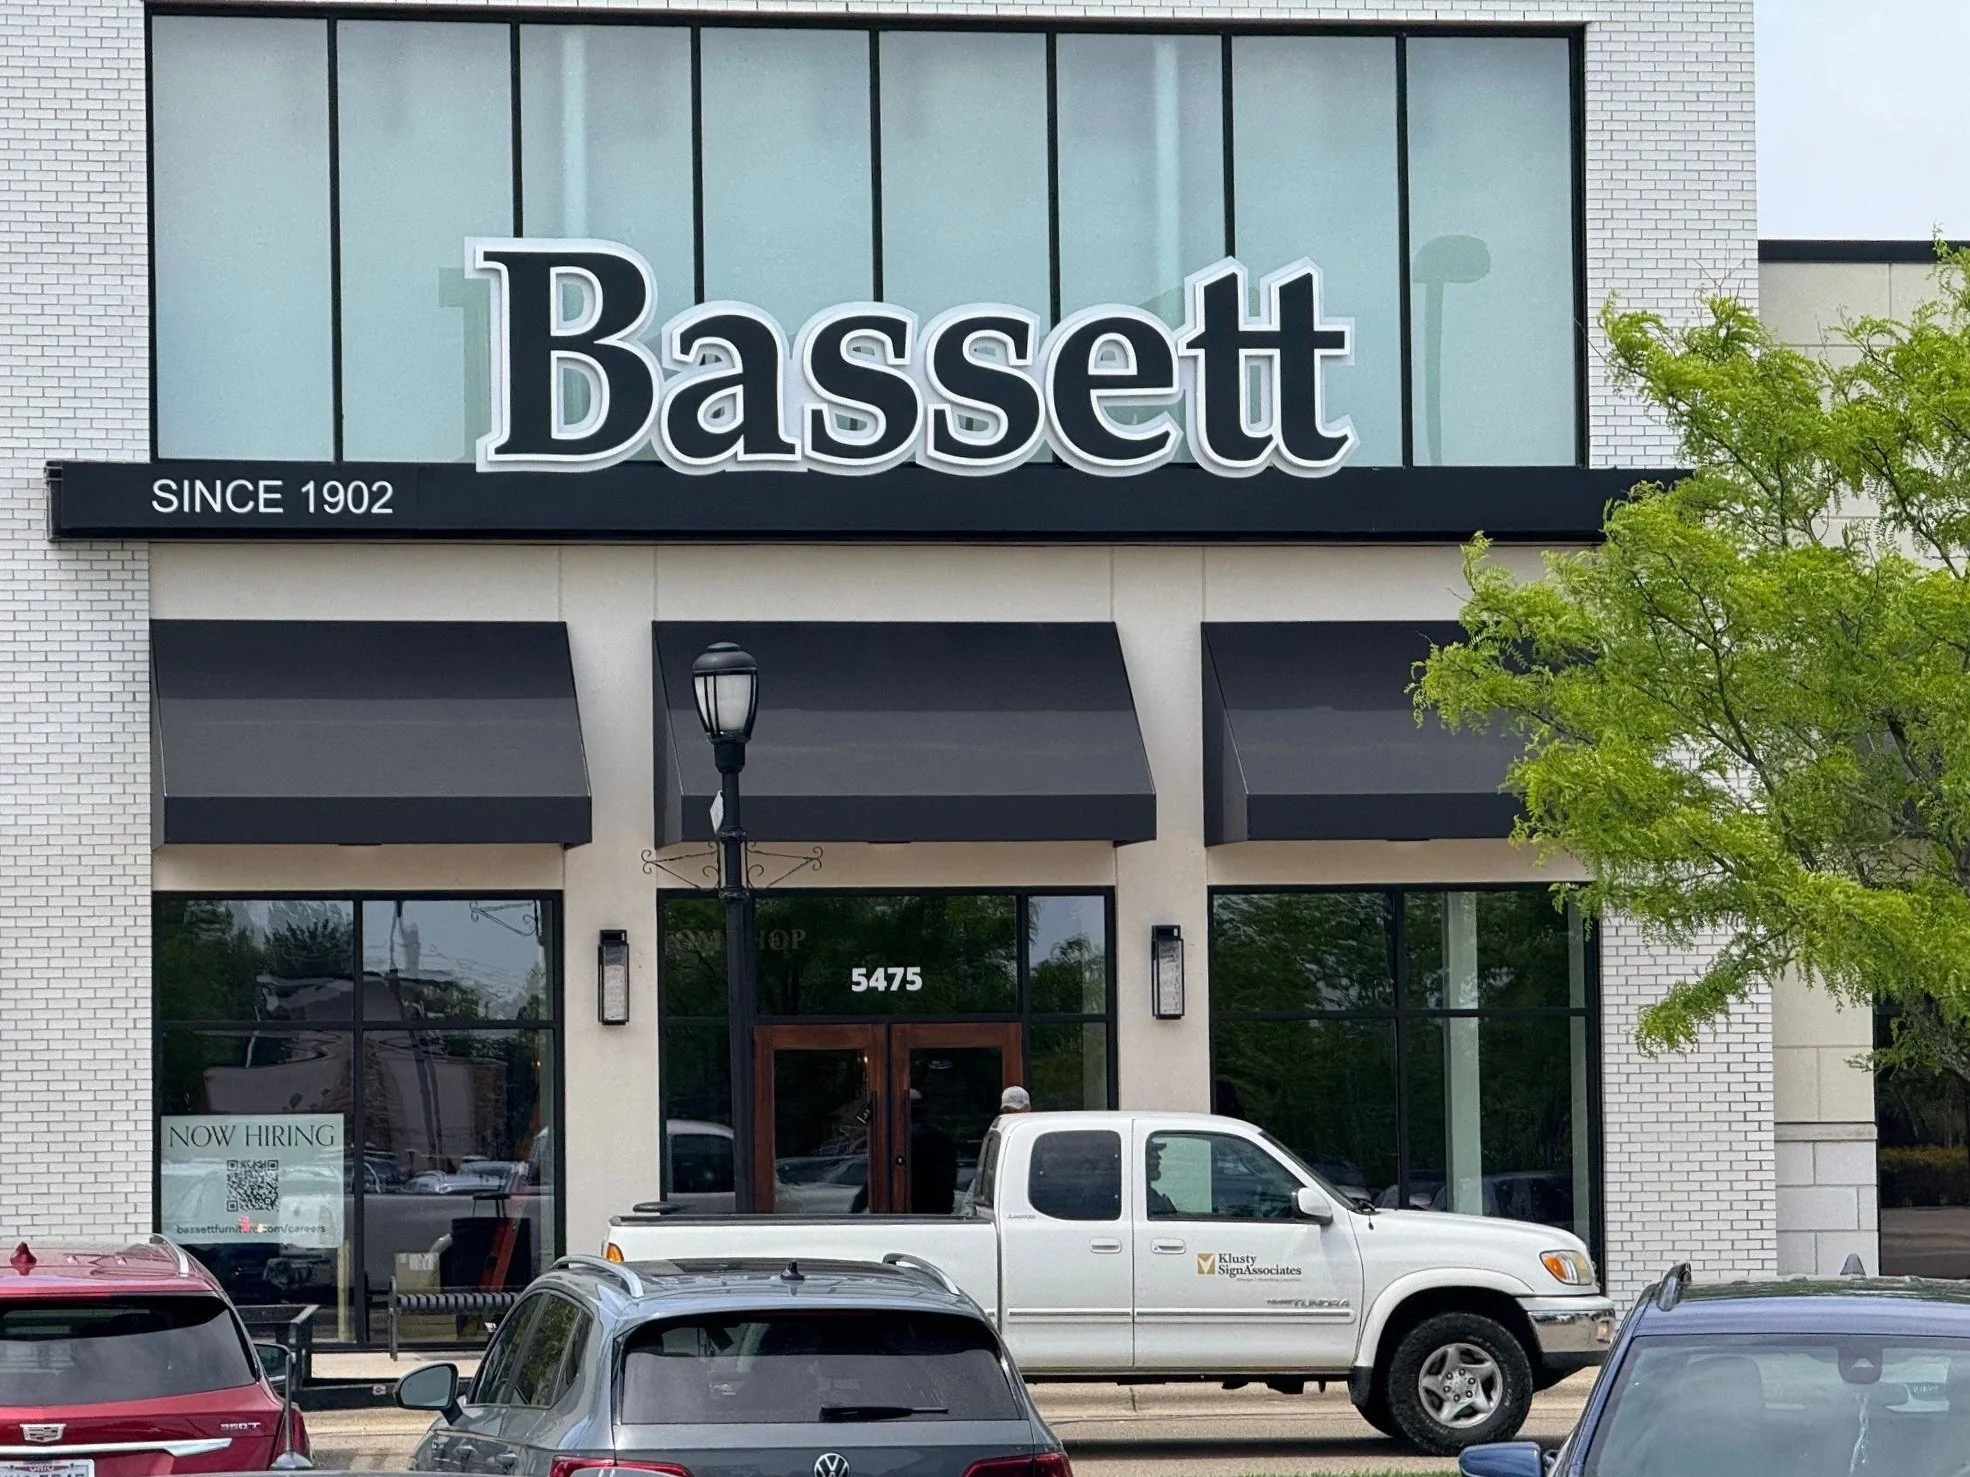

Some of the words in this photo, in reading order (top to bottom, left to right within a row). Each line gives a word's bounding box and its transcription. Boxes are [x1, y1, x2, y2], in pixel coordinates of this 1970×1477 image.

[466, 238, 1357, 476] Bassett
[151, 479, 284, 513] SINCE
[301, 480, 394, 514] 1902
[851, 967, 923, 992] 5475
[169, 1124, 236, 1147] NOW
[245, 1124, 335, 1147] HIRING
[1218, 1253, 1257, 1266] Klusty
[1218, 1264, 1302, 1278] SignAssociates
